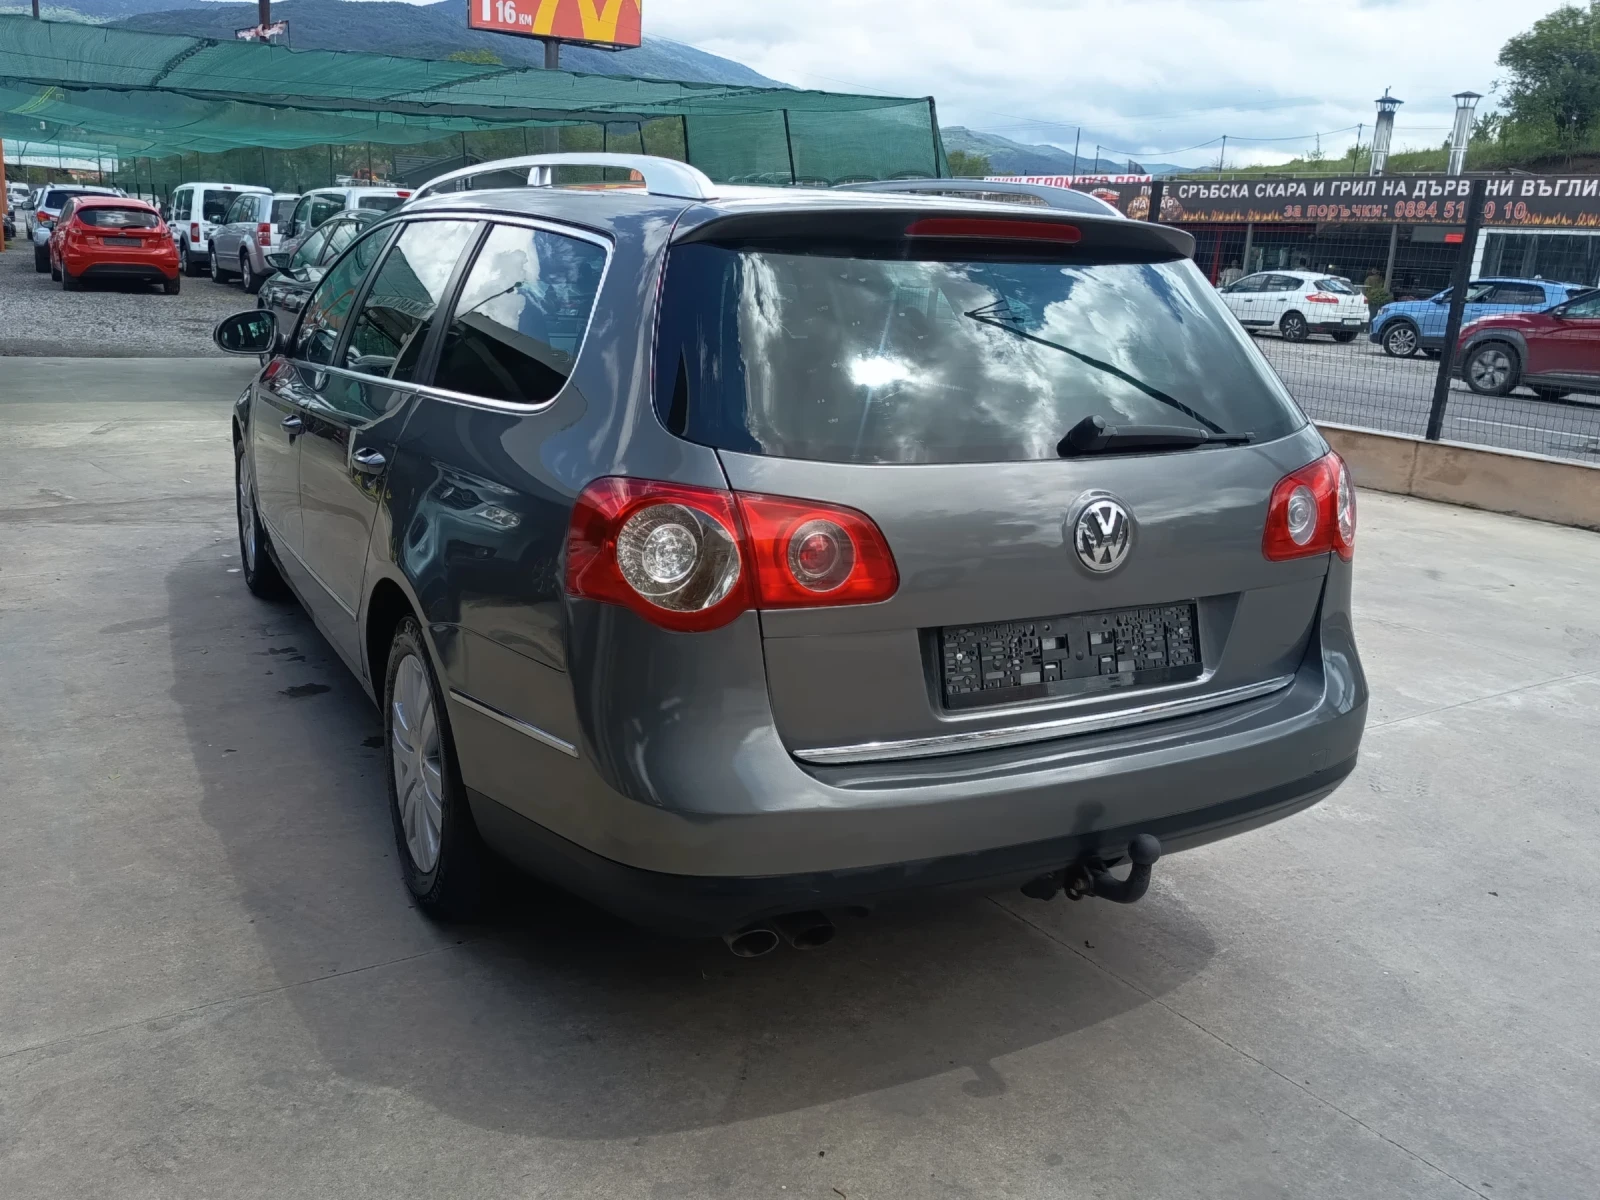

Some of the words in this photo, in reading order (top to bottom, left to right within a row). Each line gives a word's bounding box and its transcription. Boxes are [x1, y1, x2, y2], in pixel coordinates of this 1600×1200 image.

[496, 0, 516, 24] 16
[1140, 185, 1170, 196] ПИЕ
[1178, 184, 1249, 199] СРЪБСКА
[1254, 182, 1307, 198] СКАРА
[1312, 182, 1325, 197] И
[1331, 180, 1377, 197] ГРИЛ
[1381, 180, 1406, 197] НА
[1412, 180, 1515, 198] ДЪРВНИ
[1133, 199, 1147, 209] НА
[1160, 199, 1174, 209] АР
[1283, 205, 1302, 218] за
[1306, 204, 1387, 219] поръчки:
[1394, 200, 1438, 218] 0884
